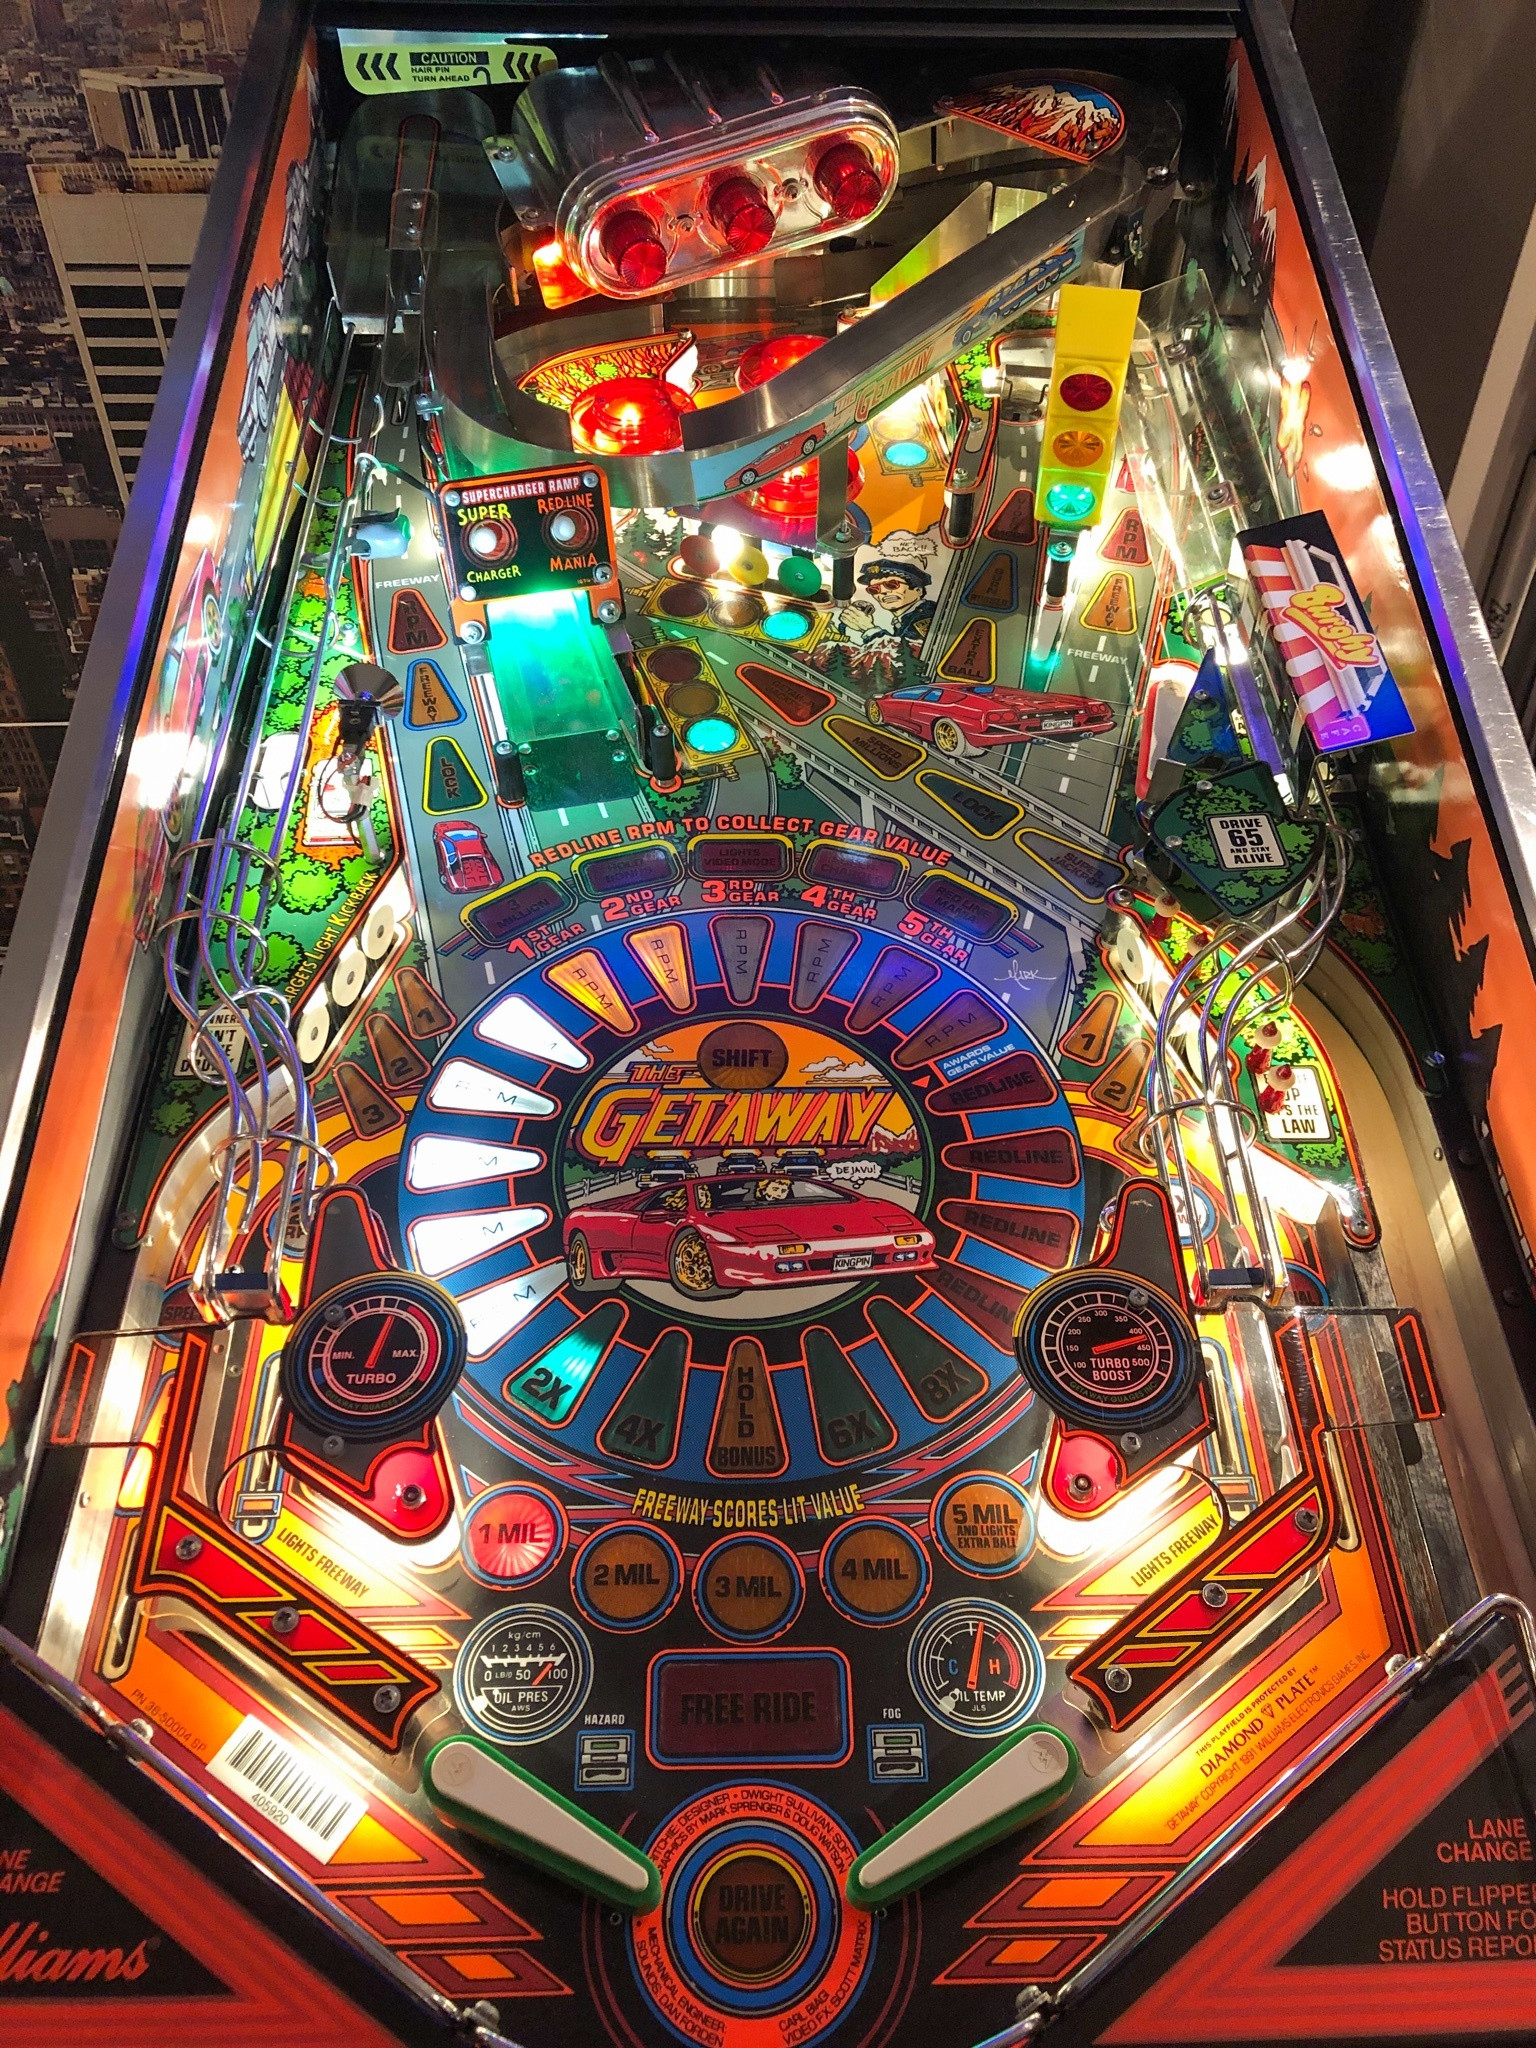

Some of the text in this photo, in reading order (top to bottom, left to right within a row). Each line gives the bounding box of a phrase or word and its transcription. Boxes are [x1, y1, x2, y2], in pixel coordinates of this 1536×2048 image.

[411, 66, 433, 74] HAIR
[421, 53, 477, 65] CAUTION
[462, 477, 580, 504] SUPERCHARGER RAMP
[457, 503, 511, 526] SUPER
[1115, 518, 1140, 559] RPM
[467, 565, 521, 583] CHARGER
[550, 553, 597, 572] MANIA
[375, 573, 440, 589] FREEWAY
[1105, 578, 1124, 627] FREEWAY
[402, 600, 429, 645] RPM
[1067, 648, 1128, 665] FREEWAY
[947, 665, 984, 679] BALL
[418, 666, 437, 722] FREEWAY
[1043, 719, 1073, 730] KINGPIN
[851, 736, 901, 768] MILLIONS
[866, 733, 901, 761] SPEED
[440, 757, 460, 800] LOCK
[952, 790, 1003, 823] LOCK
[1219, 816, 1263, 830] DRIVE
[529, 816, 953, 868] REDLINE RPM TO COLLECT GEAR VALUE
[1228, 829, 1263, 847] 65
[704, 858, 777, 867] VIDEO MODE
[1233, 852, 1274, 866] ALIVE
[630, 895, 681, 917] GEAR
[728, 889, 779, 902] GEAR
[313, 925, 341, 962] LIGHT
[329, 872, 379, 927] KICKBACK
[827, 900, 877, 921] GEAR
[537, 923, 585, 951] GEAR
[920, 931, 969, 962] GEAR
[651, 939, 678, 983] RPM
[736, 929, 748, 975] RPM
[807, 938, 833, 983] RPM
[572, 968, 613, 1010] RPM
[871, 965, 911, 1007] RPM
[925, 1010, 978, 1048] RPM
[1080, 1033, 1097, 1051] 1
[391, 1057, 413, 1077] 2
[712, 1048, 773, 1069] SHIFT
[942, 1045, 992, 1070] AWARDS
[946, 1043, 1016, 1078] GEAR VALUE
[629, 1064, 686, 1084] THE
[947, 1071, 1035, 1106] REDLINE
[1103, 1081, 1127, 1101] 2
[362, 1105, 384, 1124] 3
[1297, 1104, 1319, 1116] THE
[581, 1087, 893, 1166] GETAWAY
[1281, 1119, 1316, 1134] LAW
[969, 1148, 1063, 1165] REDLINE
[963, 1208, 1062, 1248] REDLINE
[834, 1257, 871, 1268] KINGPIN
[1067, 1328, 1081, 1336] 200
[1129, 1327, 1143, 1335] 400
[332, 1349, 419, 1360] MIN. MAX.
[1066, 1344, 1079, 1352] 150
[1137, 1344, 1151, 1352] 450
[1073, 1361, 1086, 1369] 100
[1090, 1357, 1130, 1369] TURBO
[1132, 1358, 1150, 1367] 500
[346, 1373, 396, 1385] TURBO
[919, 1359, 970, 1402] 8X
[1093, 1370, 1132, 1381] BOOST
[520, 1367, 573, 1411] 2X
[737, 1366, 754, 1438] HOLD
[616, 1413, 665, 1452] 4X
[827, 1409, 877, 1448] 6X
[717, 1446, 776, 1468] BONUS
[632, 1484, 865, 1528] FREEWAY SCORES LIT VALUE
[953, 1504, 1018, 1524] 5 MIL
[479, 1522, 543, 1544] 1 MIL
[957, 1525, 1016, 1537] AND LIGHTS
[957, 1536, 1017, 1549] EXTRA BALL
[1130, 1514, 1219, 1587] LIGHTS FREEWAY
[276, 1527, 370, 1599] LIGHTS FREEWAY
[841, 1557, 909, 1581] 4 MIL
[593, 1563, 660, 1587] 2 MIL
[715, 1575, 782, 1599] 3 MIL
[508, 1630, 541, 1641] kg/cm
[515, 1667, 568, 1681] 50 100
[949, 1659, 1001, 1676] C H
[518, 1690, 548, 1703] PRES
[974, 1690, 1006, 1702] TEMP
[511, 1704, 531, 1712] AWS
[584, 1713, 625, 1726] HAZARD
[680, 1691, 816, 1725] FREE RIDE
[883, 1707, 901, 1720] FOG
[971, 1704, 986, 1712] JLS
[1211, 1676, 1288, 1744] PLAYFIELD PROTECTED
[1200, 1682, 1333, 1802] COPYRIGHT WILLIAMS ELECTRONICS
[1200, 1717, 1264, 1778] DIAMOND
[250, 1793, 290, 1827] 405920
[678, 1789, 784, 1827] DESIGNER DWIGHT
[700, 1801, 847, 1875] MARK SPRENGER DOUG WATSON
[1468, 1818, 1527, 1841] LANE
[1436, 1841, 1533, 1864] CHANGE
[719, 1885, 786, 1912] DRIVE
[1382, 1883, 1536, 1910] HOLD FLIPPE
[716, 1915, 790, 1945] AGAIN
[1406, 1911, 1501, 1935] BUTTON
[648, 1926, 680, 1998] MECHANICAL
[1379, 1938, 1462, 1964] STATUS
[782, 1919, 868, 2046] VIDEO SCOTT MATRIX
[659, 1992, 724, 2047] DAN FORDEN
[779, 2008, 807, 2032] CARL
